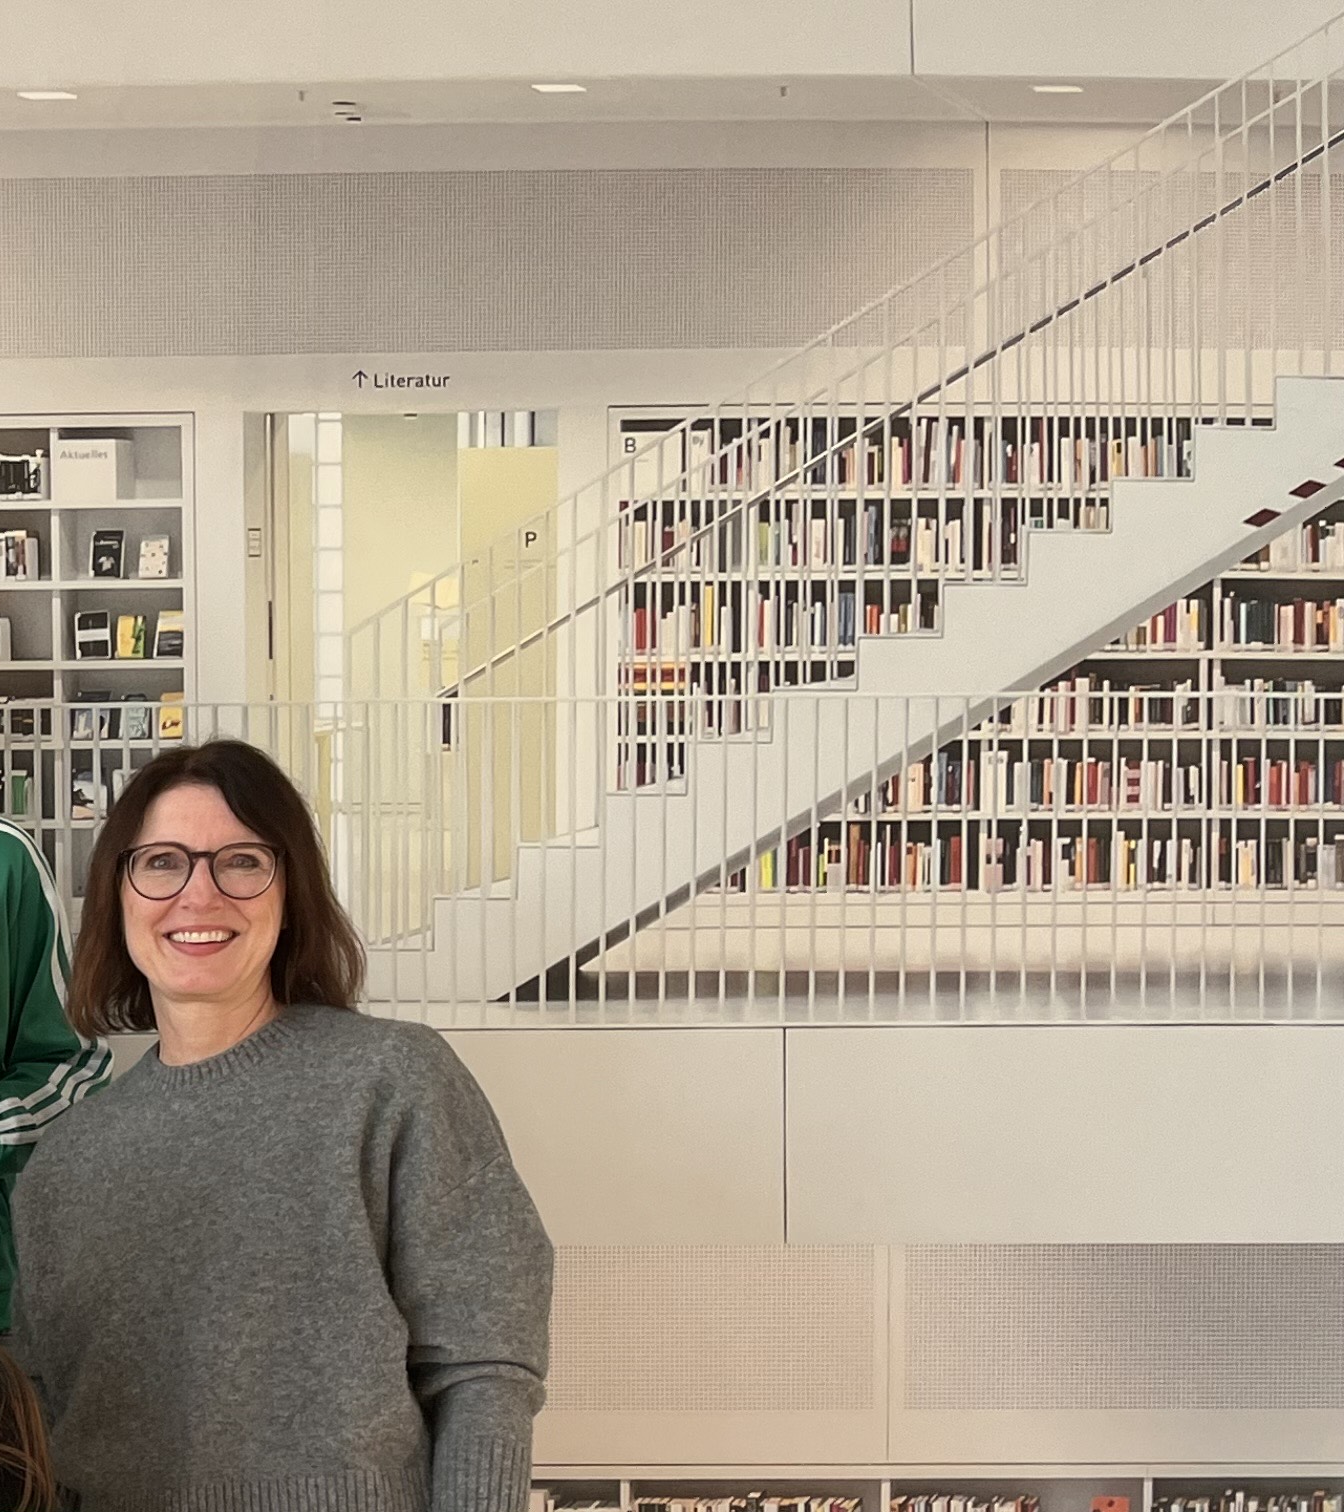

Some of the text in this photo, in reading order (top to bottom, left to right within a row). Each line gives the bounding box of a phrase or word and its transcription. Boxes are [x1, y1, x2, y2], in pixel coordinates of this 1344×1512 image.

[374, 372, 450, 389] Literatur
[624, 436, 636, 453] B
[525, 531, 537, 548] P
